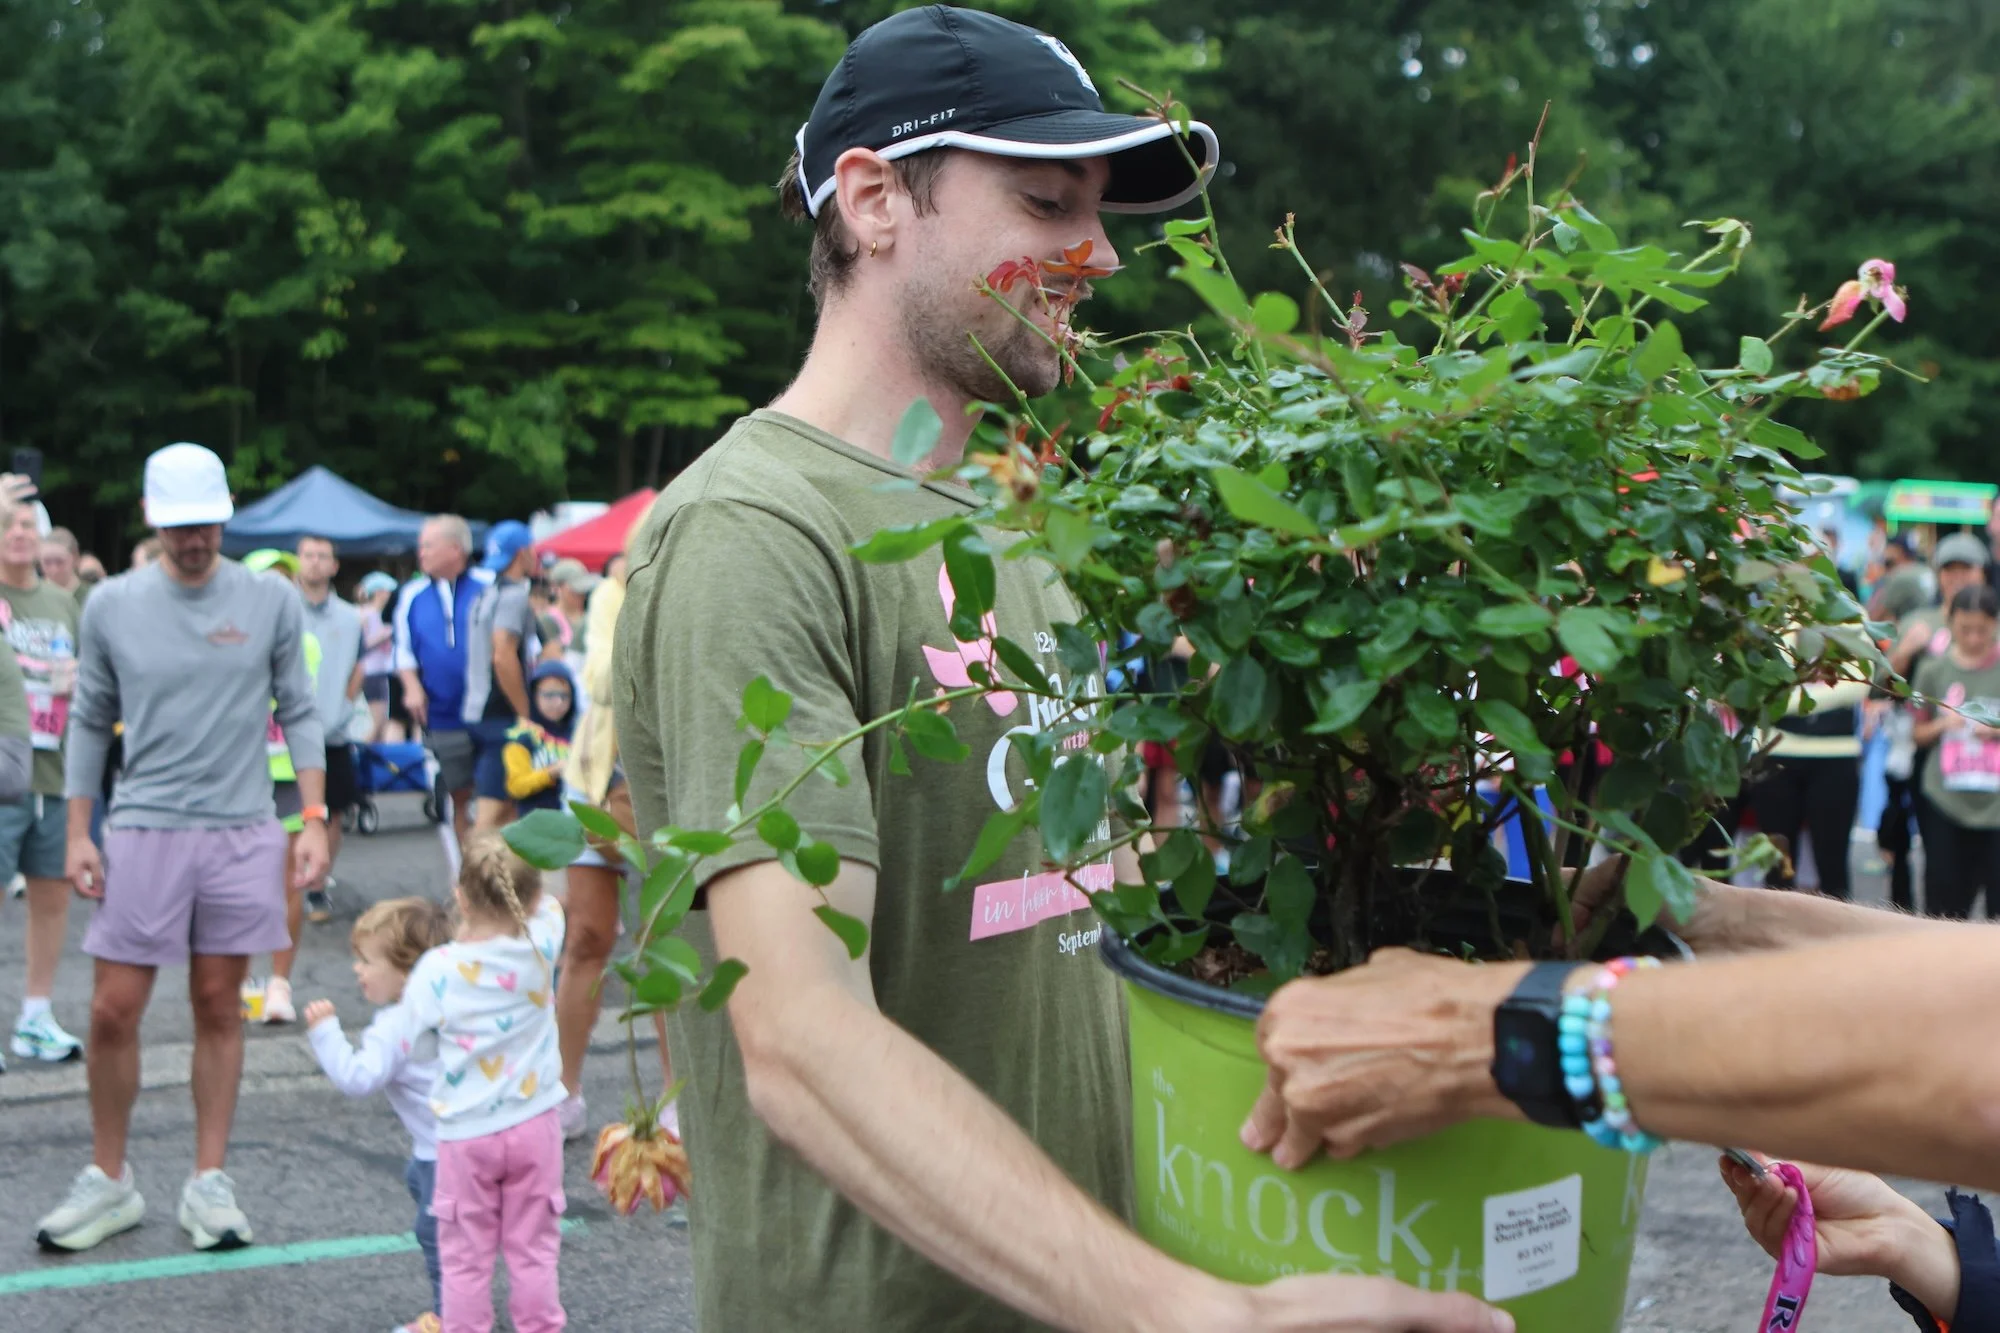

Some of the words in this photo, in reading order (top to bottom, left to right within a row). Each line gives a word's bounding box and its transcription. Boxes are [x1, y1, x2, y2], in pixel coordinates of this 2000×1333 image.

[892, 107, 957, 138] DRI-FIT
[984, 893, 1015, 924] in
[1153, 1066, 1175, 1098] the
[1154, 1097, 1440, 1268] knock
